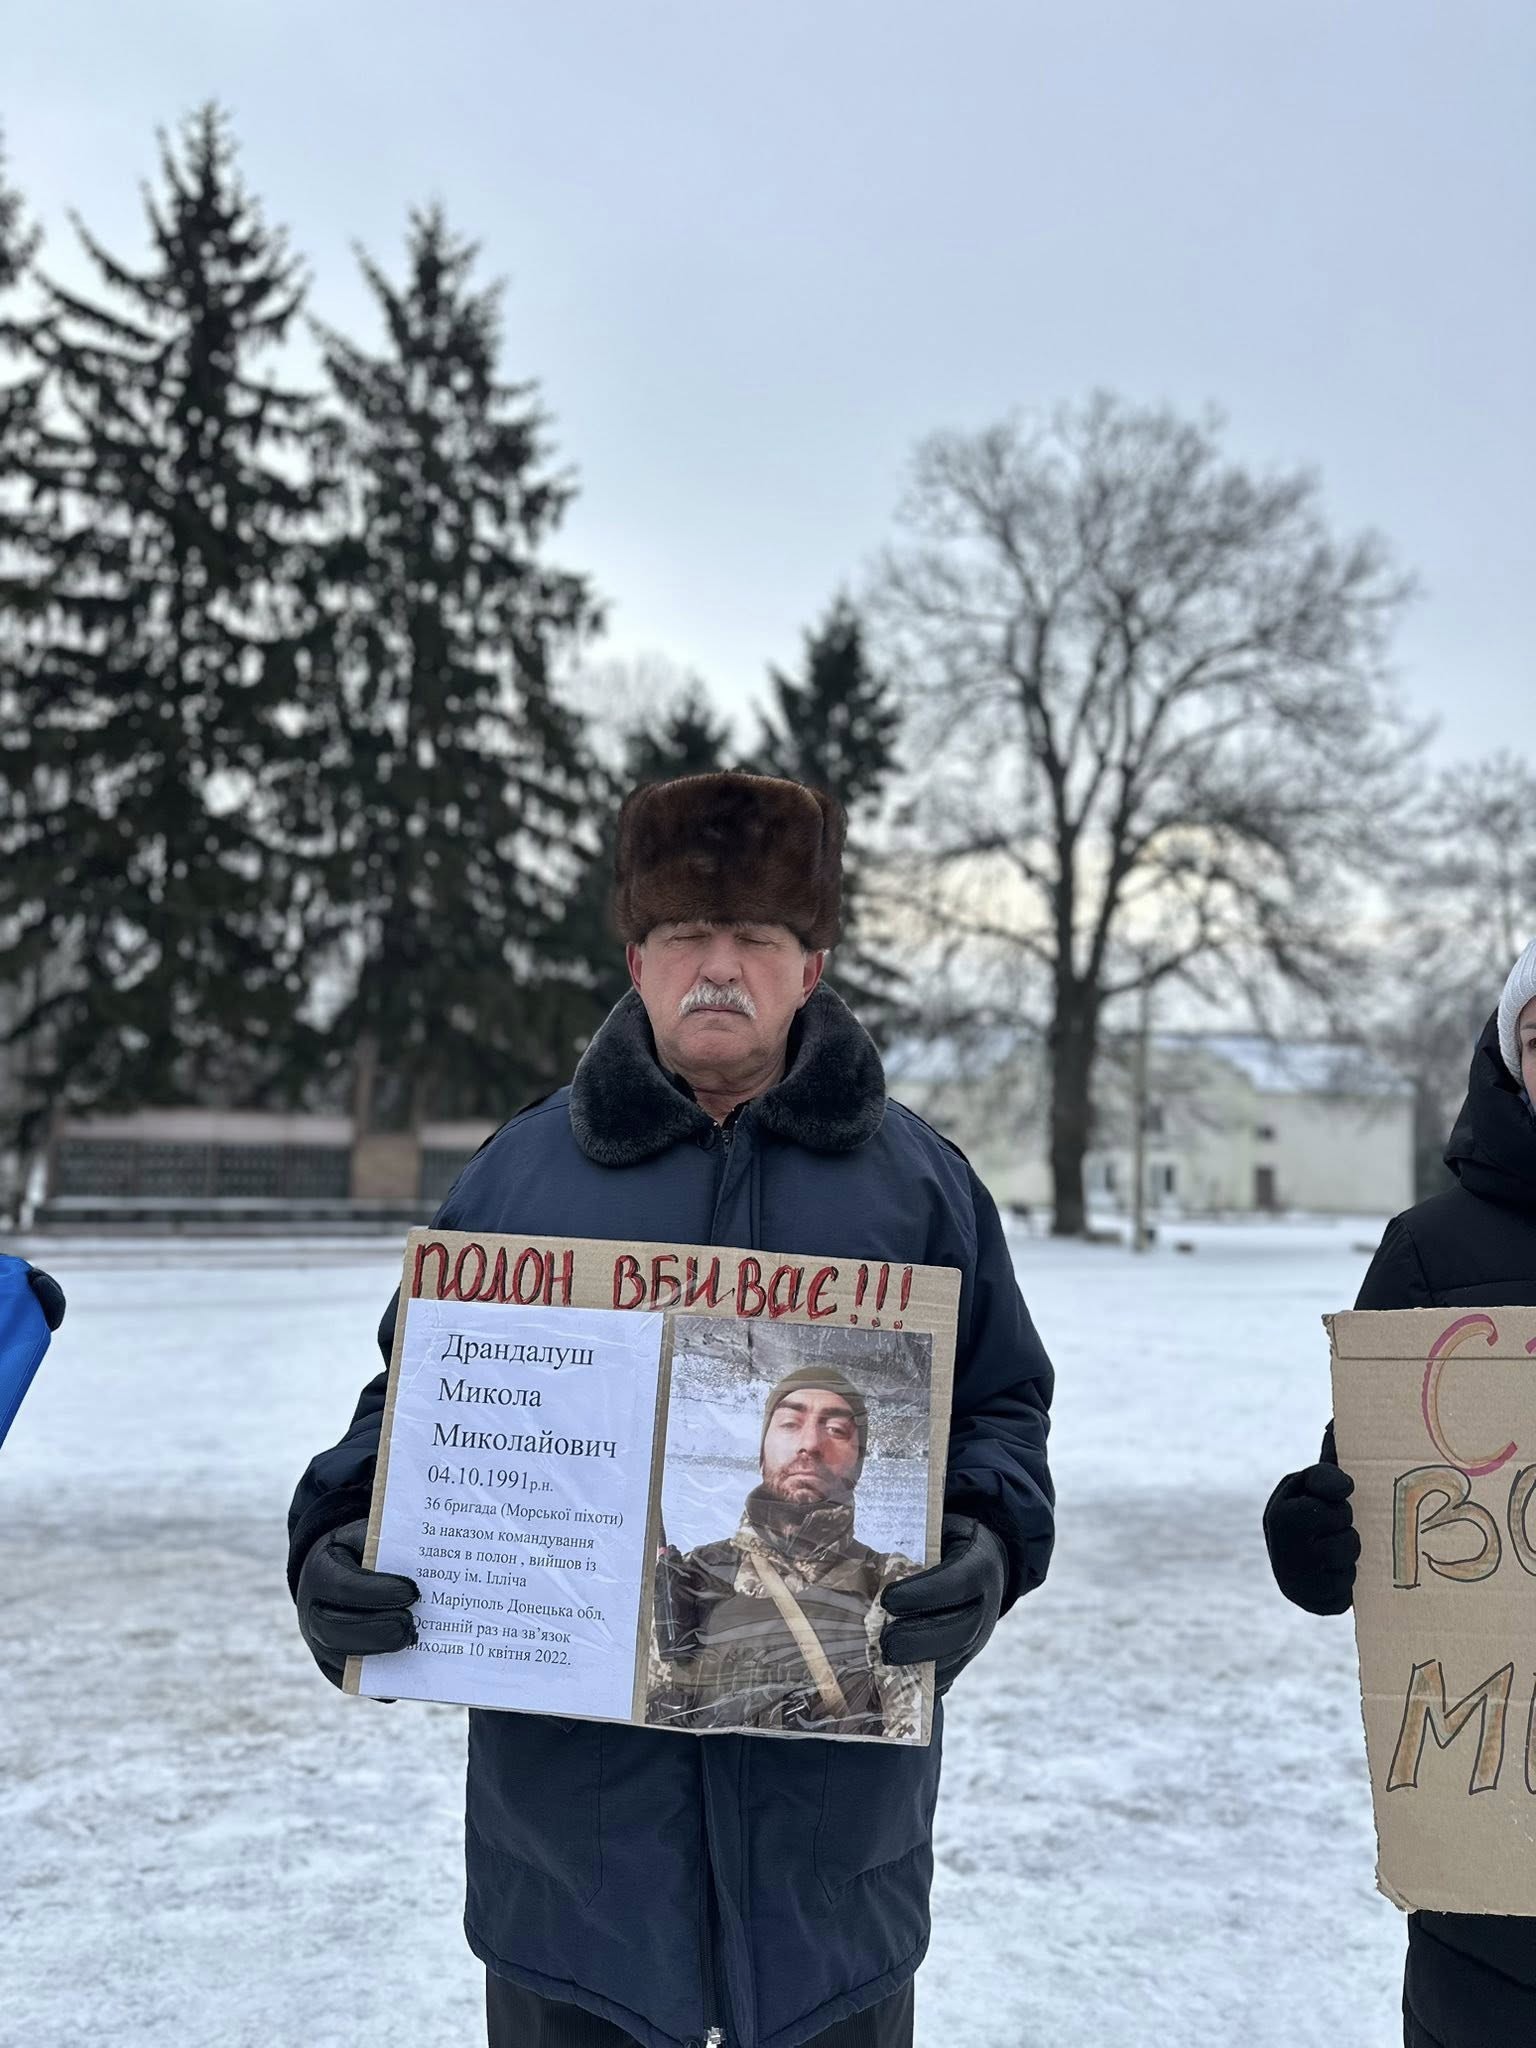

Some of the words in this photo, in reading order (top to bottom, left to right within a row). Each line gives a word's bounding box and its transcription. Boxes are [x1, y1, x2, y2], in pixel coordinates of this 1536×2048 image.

[411, 1241, 574, 1306] ПОЛОН
[440, 1333, 596, 1370] Драндалуш
[437, 1377, 543, 1408] Микола
[1421, 1313, 1536, 1477] С
[431, 1422, 618, 1459] Миколайович
[424, 1496, 441, 1511] 36
[443, 1498, 497, 1516] бригада
[500, 1502, 571, 1522] (Морської
[573, 1508, 625, 1528] піхоти)
[421, 1521, 436, 1536] За
[439, 1526, 494, 1541] наказом
[498, 1531, 595, 1549] командування
[418, 1545, 461, 1561] здався
[465, 1550, 473, 1560] в
[476, 1551, 517, 1565] полон
[529, 1554, 582, 1571] вийшов
[585, 1557, 597, 1572] із
[416, 1566, 461, 1584] заводу
[464, 1568, 482, 1583] ім.
[486, 1570, 528, 1588] Ілліча
[430, 1591, 504, 1612] Маріуполь
[507, 1598, 574, 1618] Донецька
[577, 1606, 606, 1621] обл.
[413, 1614, 474, 1634] Останній
[475, 1623, 499, 1638] раз
[502, 1626, 518, 1638] на
[469, 1642, 484, 1657] 10
[488, 1645, 531, 1662] квітня
[534, 1649, 572, 1666] 2022.
[1385, 1658, 1536, 1796] М
